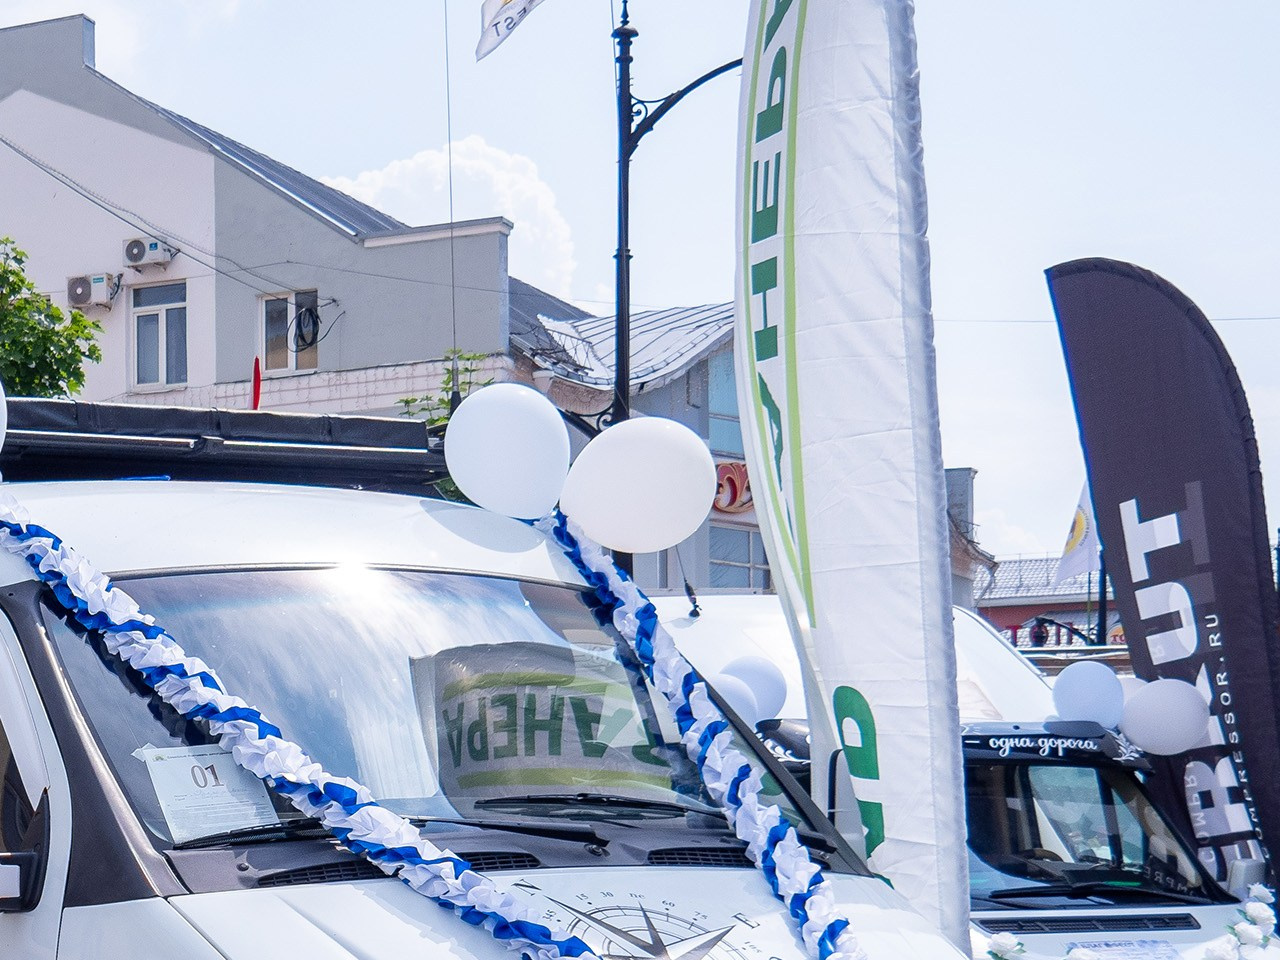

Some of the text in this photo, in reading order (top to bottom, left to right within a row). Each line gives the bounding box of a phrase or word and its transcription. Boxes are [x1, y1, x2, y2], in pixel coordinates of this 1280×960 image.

[988, 737, 1098, 757] одна дорога
[190, 764, 224, 789] 01
